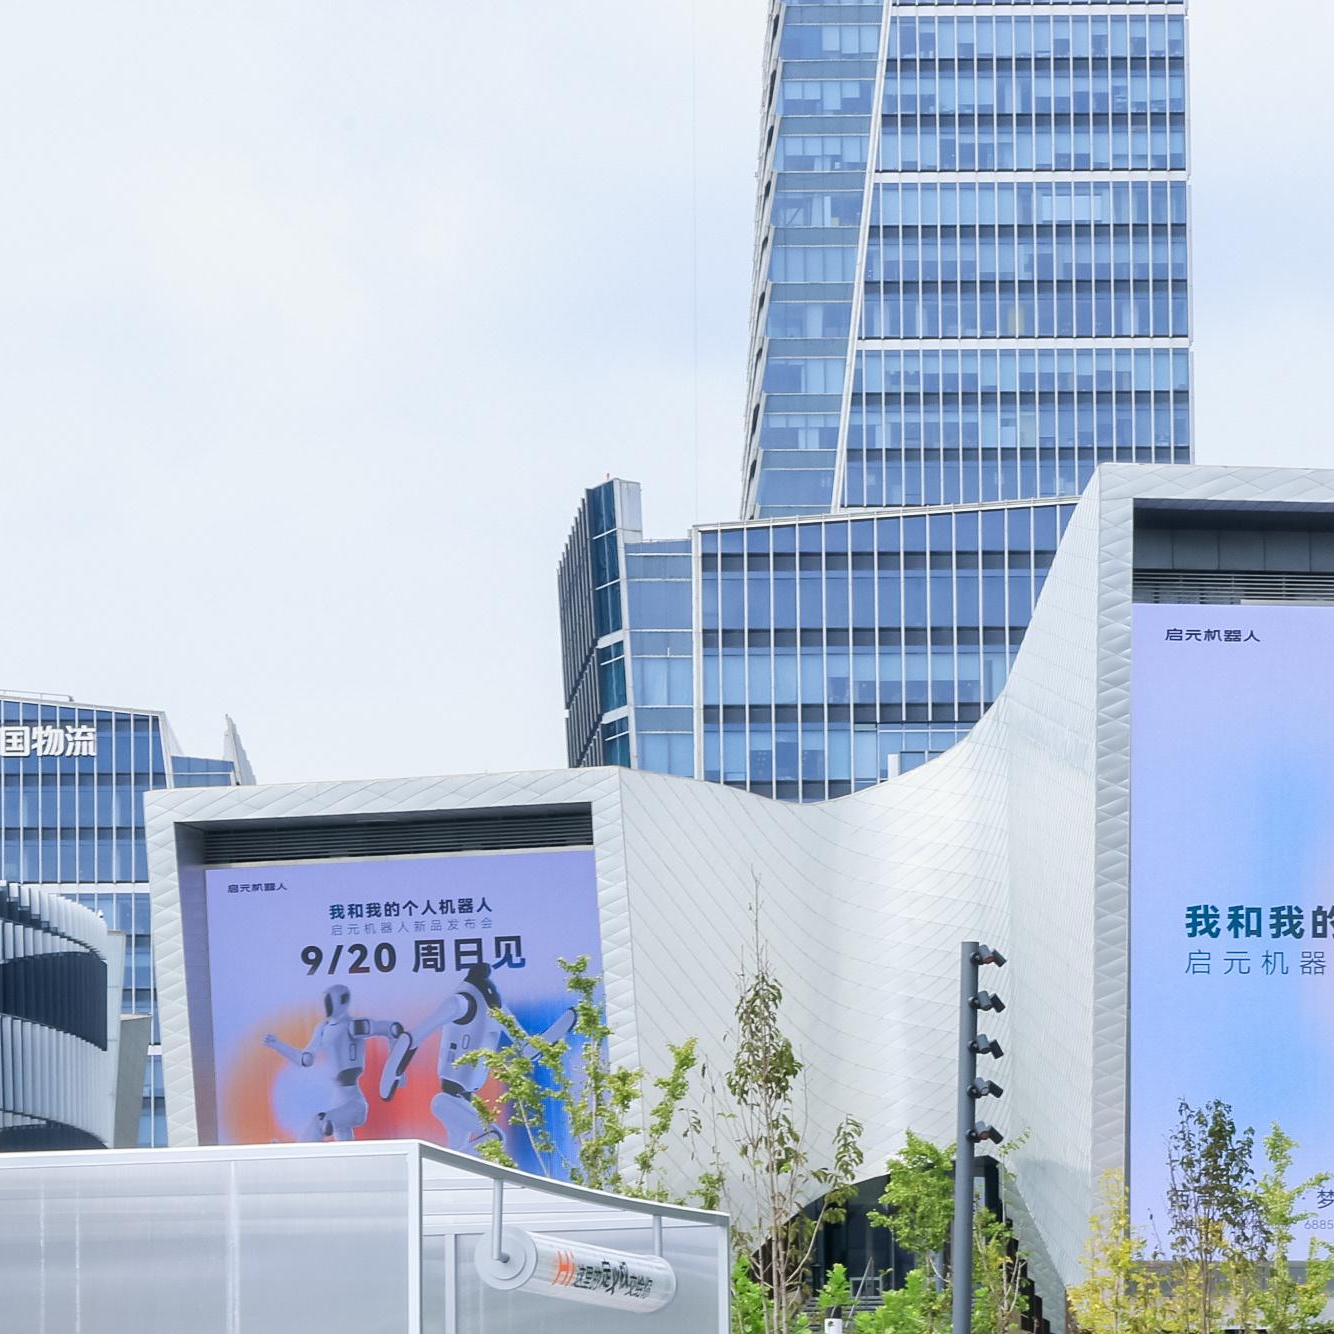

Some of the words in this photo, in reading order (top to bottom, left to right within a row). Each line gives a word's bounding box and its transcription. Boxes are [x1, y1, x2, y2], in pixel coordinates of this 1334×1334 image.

[1164, 628, 1261, 643] 启元机器人
[227, 882, 288, 894] 启元机器人
[328, 896, 494, 921] 我和我的个人机器人
[330, 917, 494, 937] 启元机器人新品发布会
[300, 941, 397, 976] 9/20
[412, 935, 527, 974] 周日见
